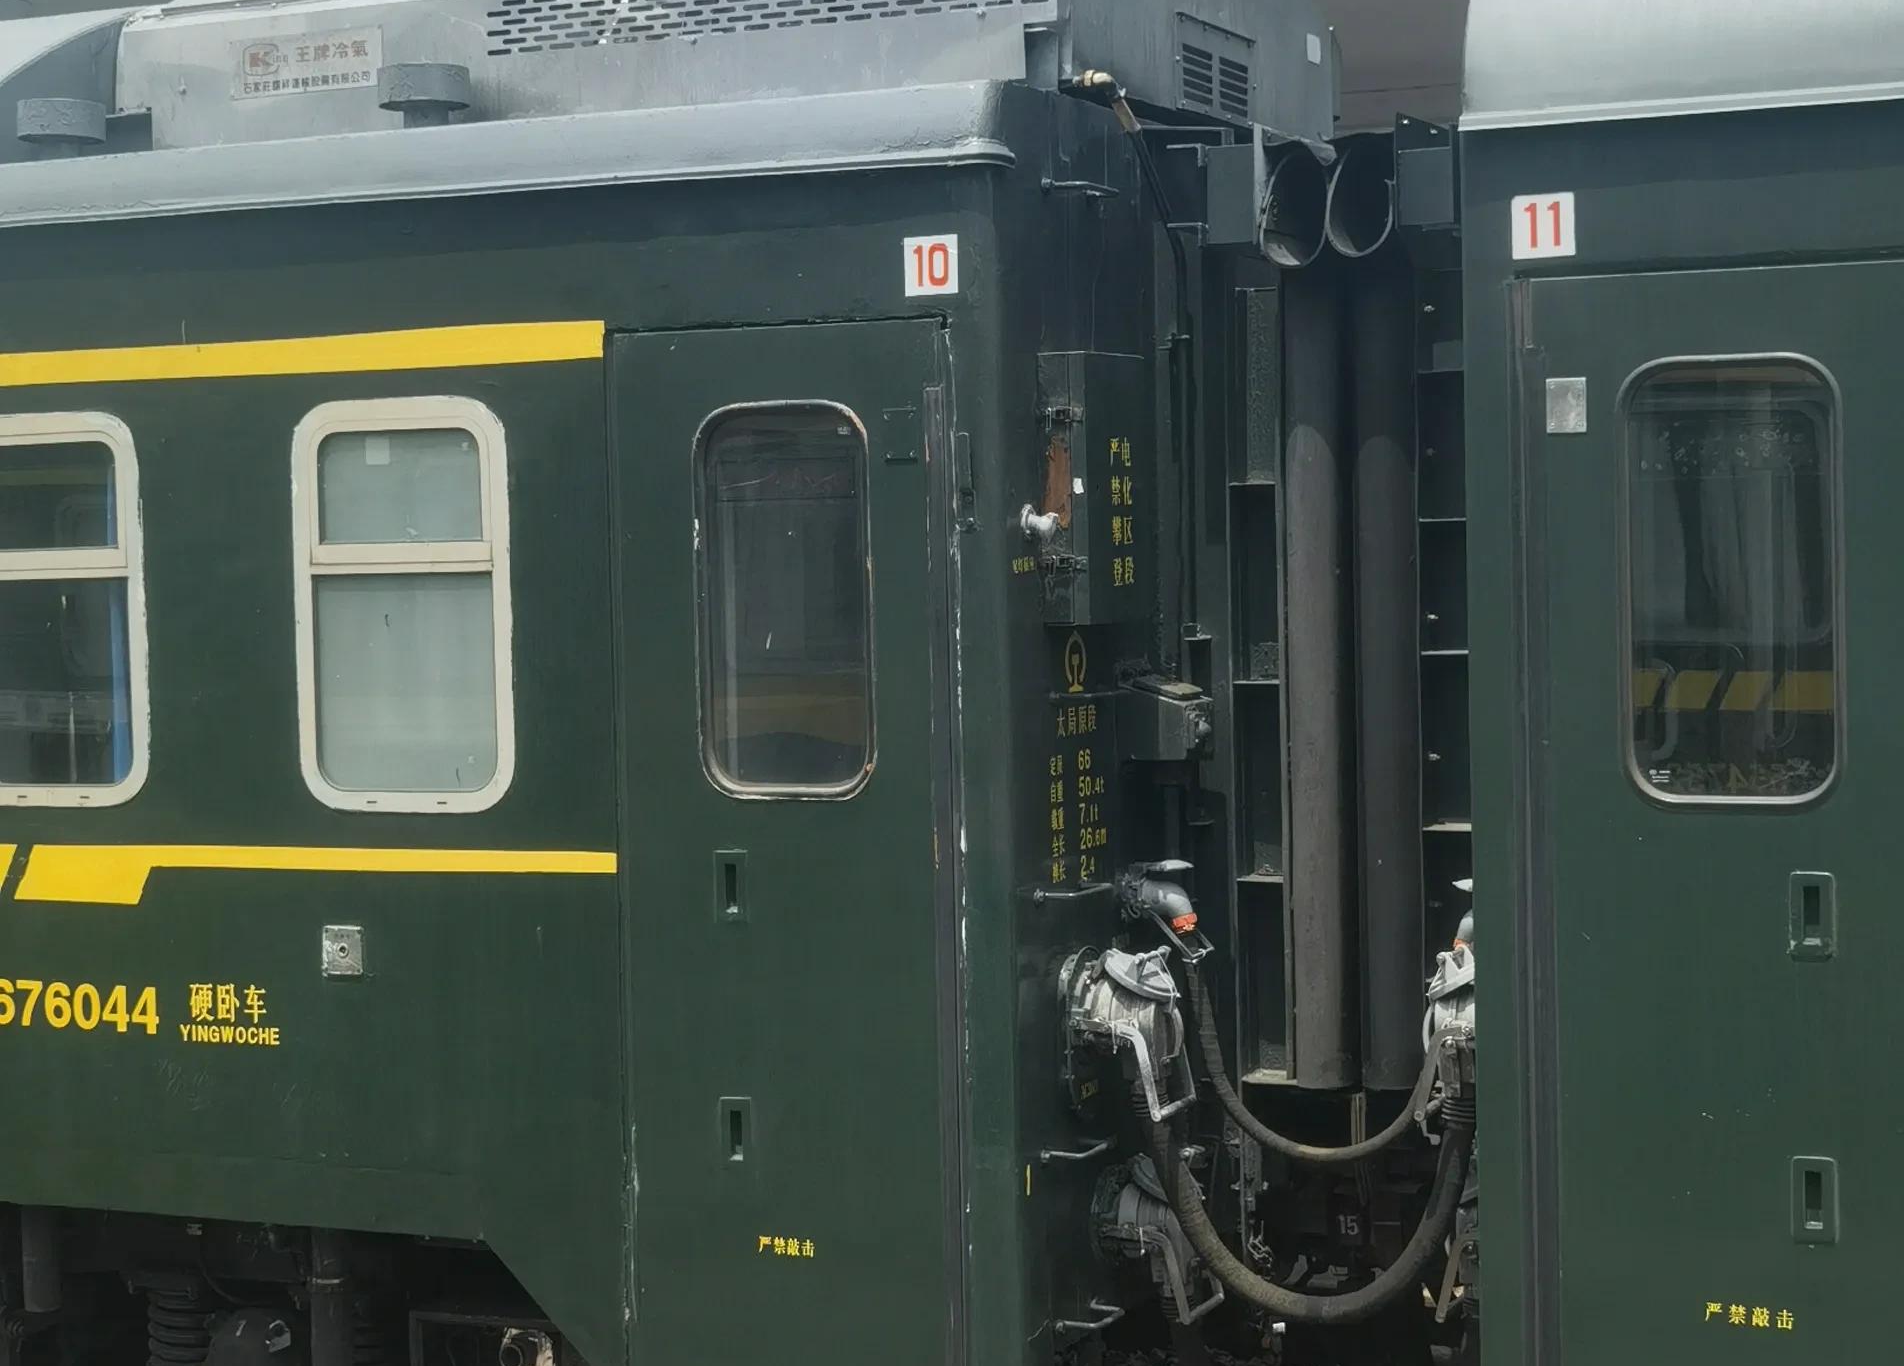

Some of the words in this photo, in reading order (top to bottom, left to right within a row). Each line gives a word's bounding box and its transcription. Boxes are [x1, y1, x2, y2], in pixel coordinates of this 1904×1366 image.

[295, 40, 369, 63] 王牌冷氣
[1524, 201, 1561, 249] 11
[913, 243, 949, 287] 10
[1110, 438, 1124, 586] 严禁攀登
[1121, 437, 1135, 585] 电化区段
[1078, 748, 1091, 771] 66
[1078, 776, 1104, 797] 50.4t
[1080, 855, 1095, 880] 2.4
[0, 978, 160, 1034] 676044
[189, 983, 267, 1024] 硬卧车
[179, 1024, 280, 1045] YINGWOCHE
[1338, 1214, 1359, 1235] 15
[758, 1235, 815, 1258] 严禁敲击
[1705, 1302, 1794, 1330] 严禁敲击
